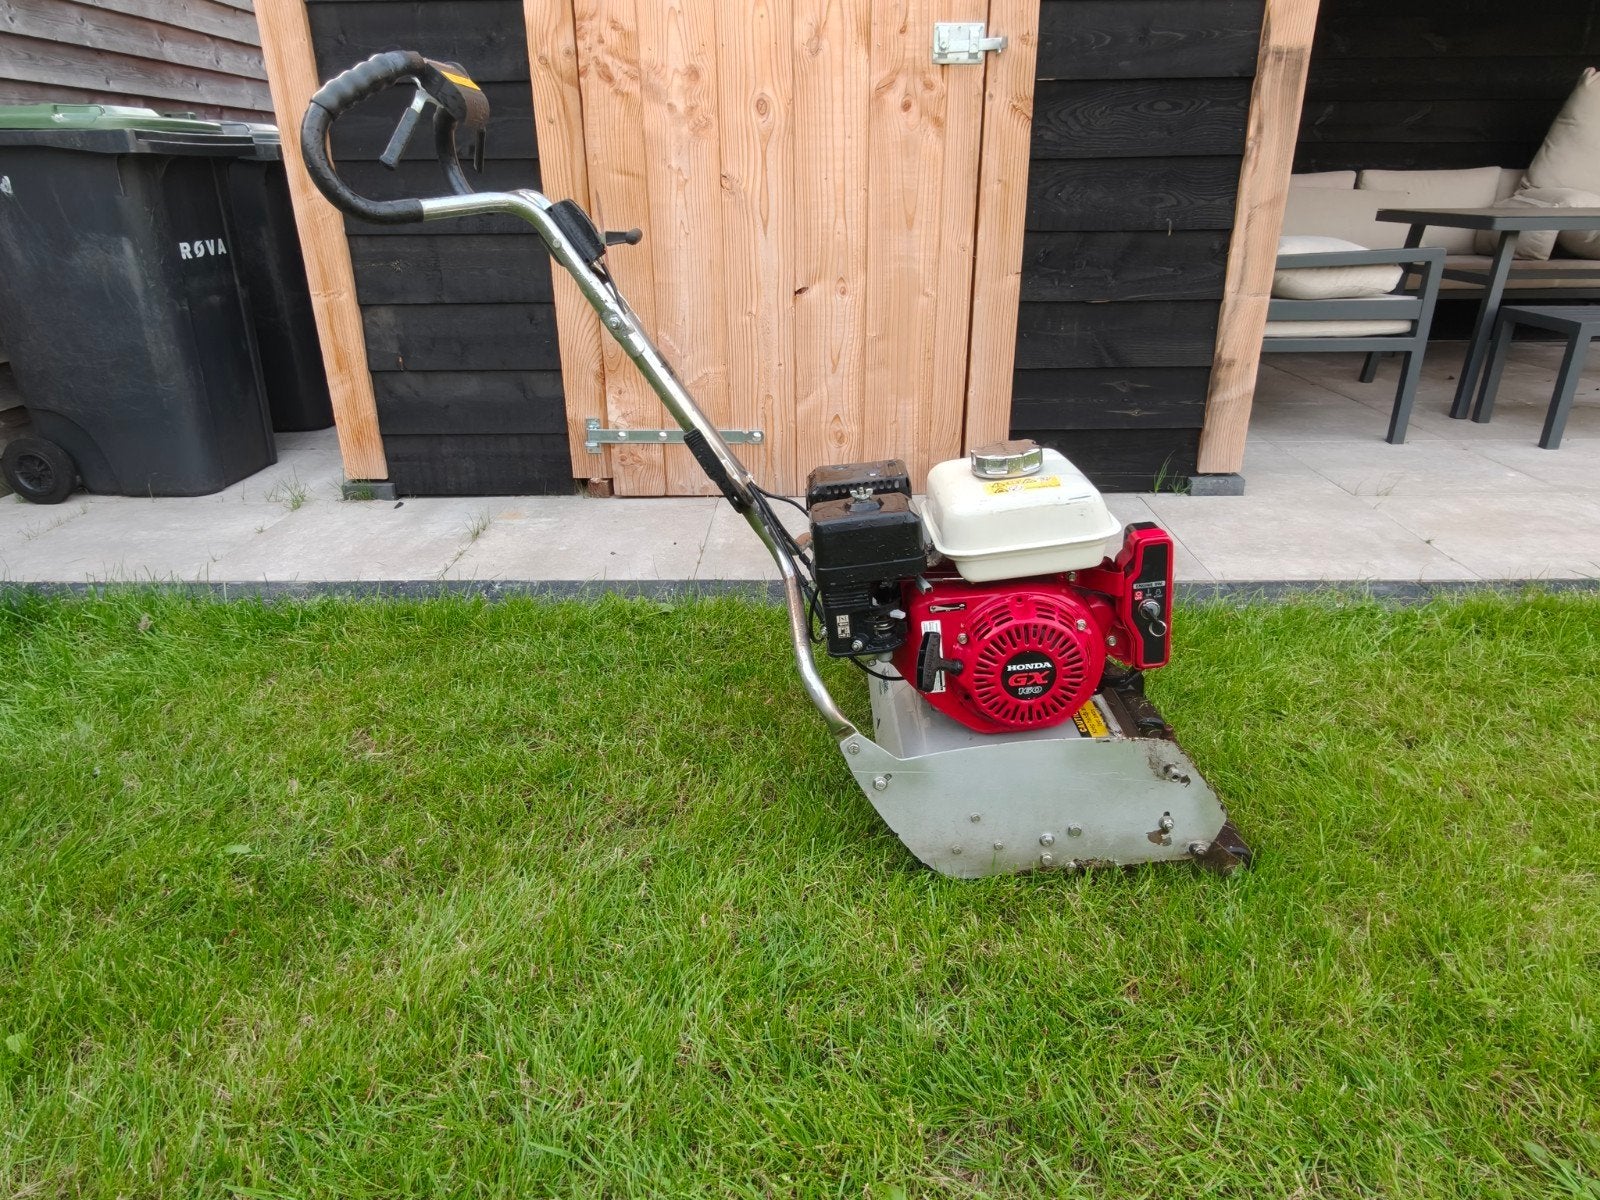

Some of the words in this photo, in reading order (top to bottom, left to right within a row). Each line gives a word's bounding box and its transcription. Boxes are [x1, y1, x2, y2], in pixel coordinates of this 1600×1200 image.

[1007, 661, 1052, 671] HONDA
[1008, 671, 1050, 686] GX
[1018, 686, 1043, 695] 160
